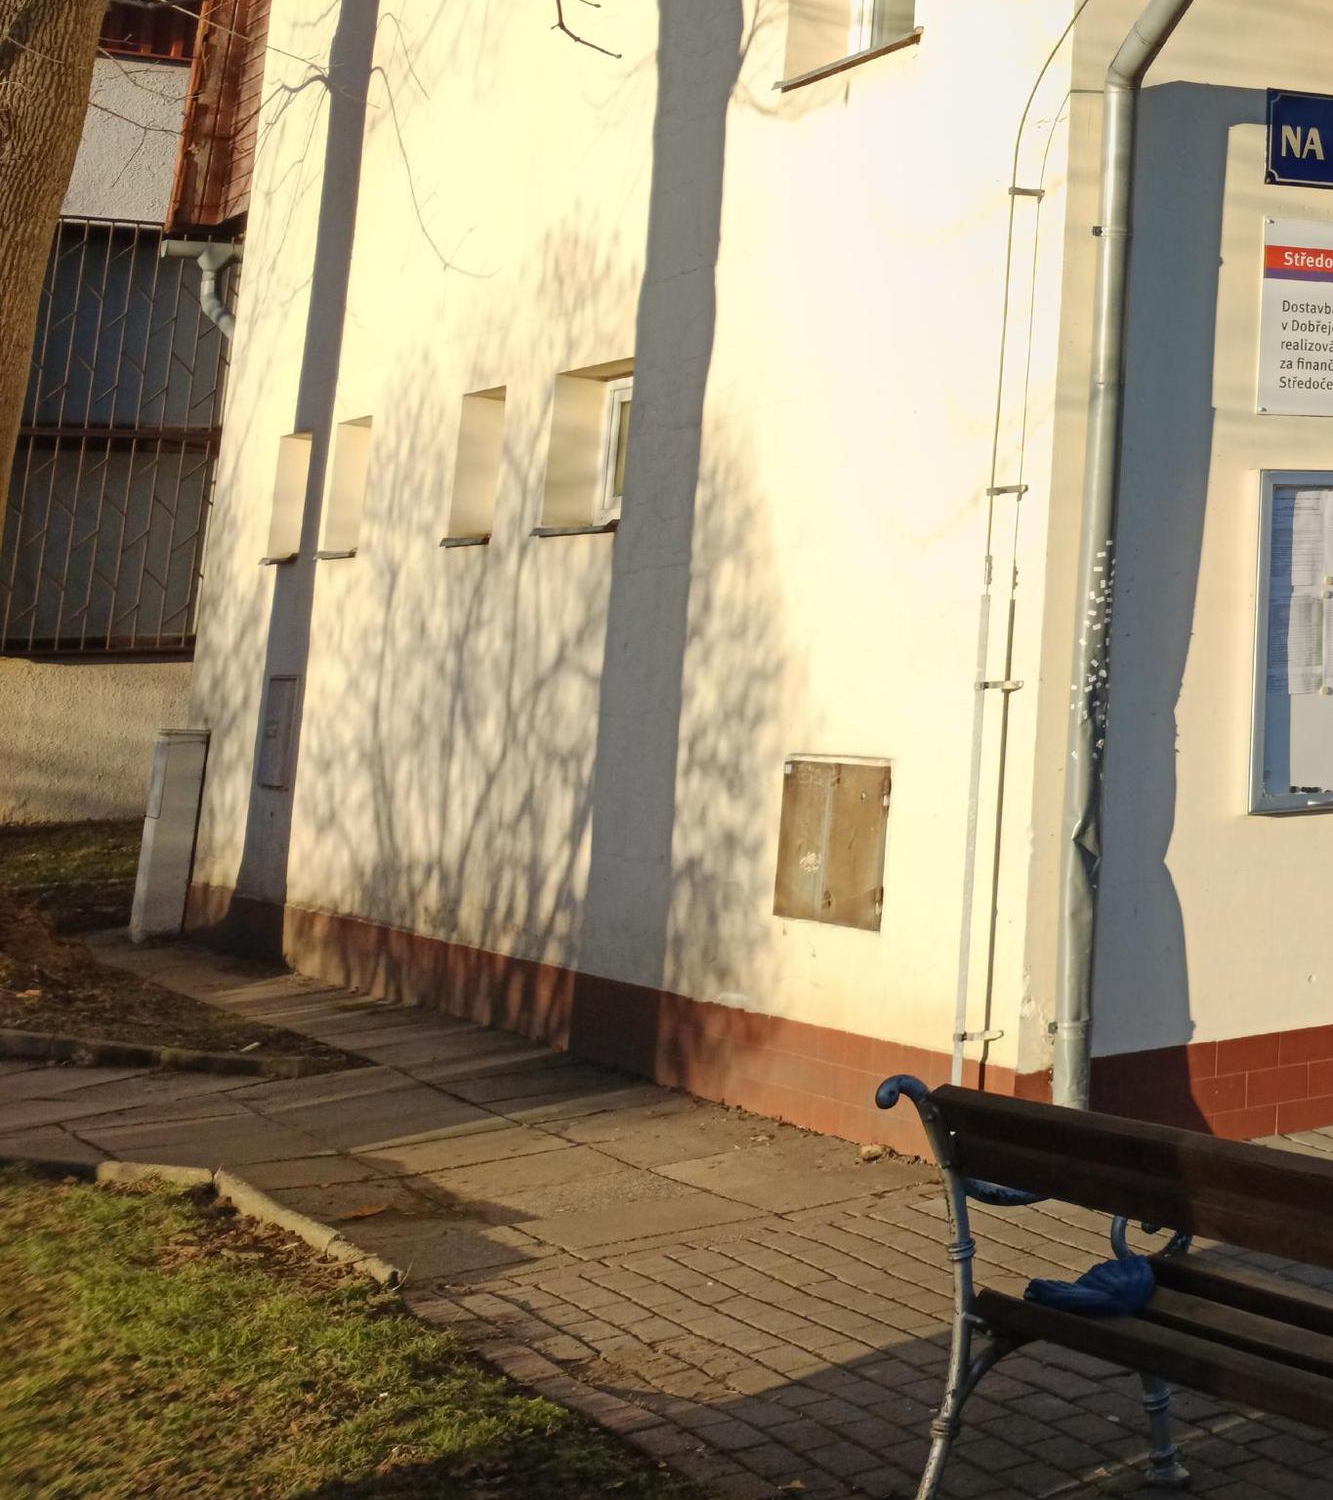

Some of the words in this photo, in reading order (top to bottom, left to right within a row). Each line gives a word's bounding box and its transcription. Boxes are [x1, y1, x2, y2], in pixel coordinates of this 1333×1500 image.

[1281, 125, 1324, 160] NA
[1281, 322, 1288, 331] v
[1280, 359, 1293, 370] za
